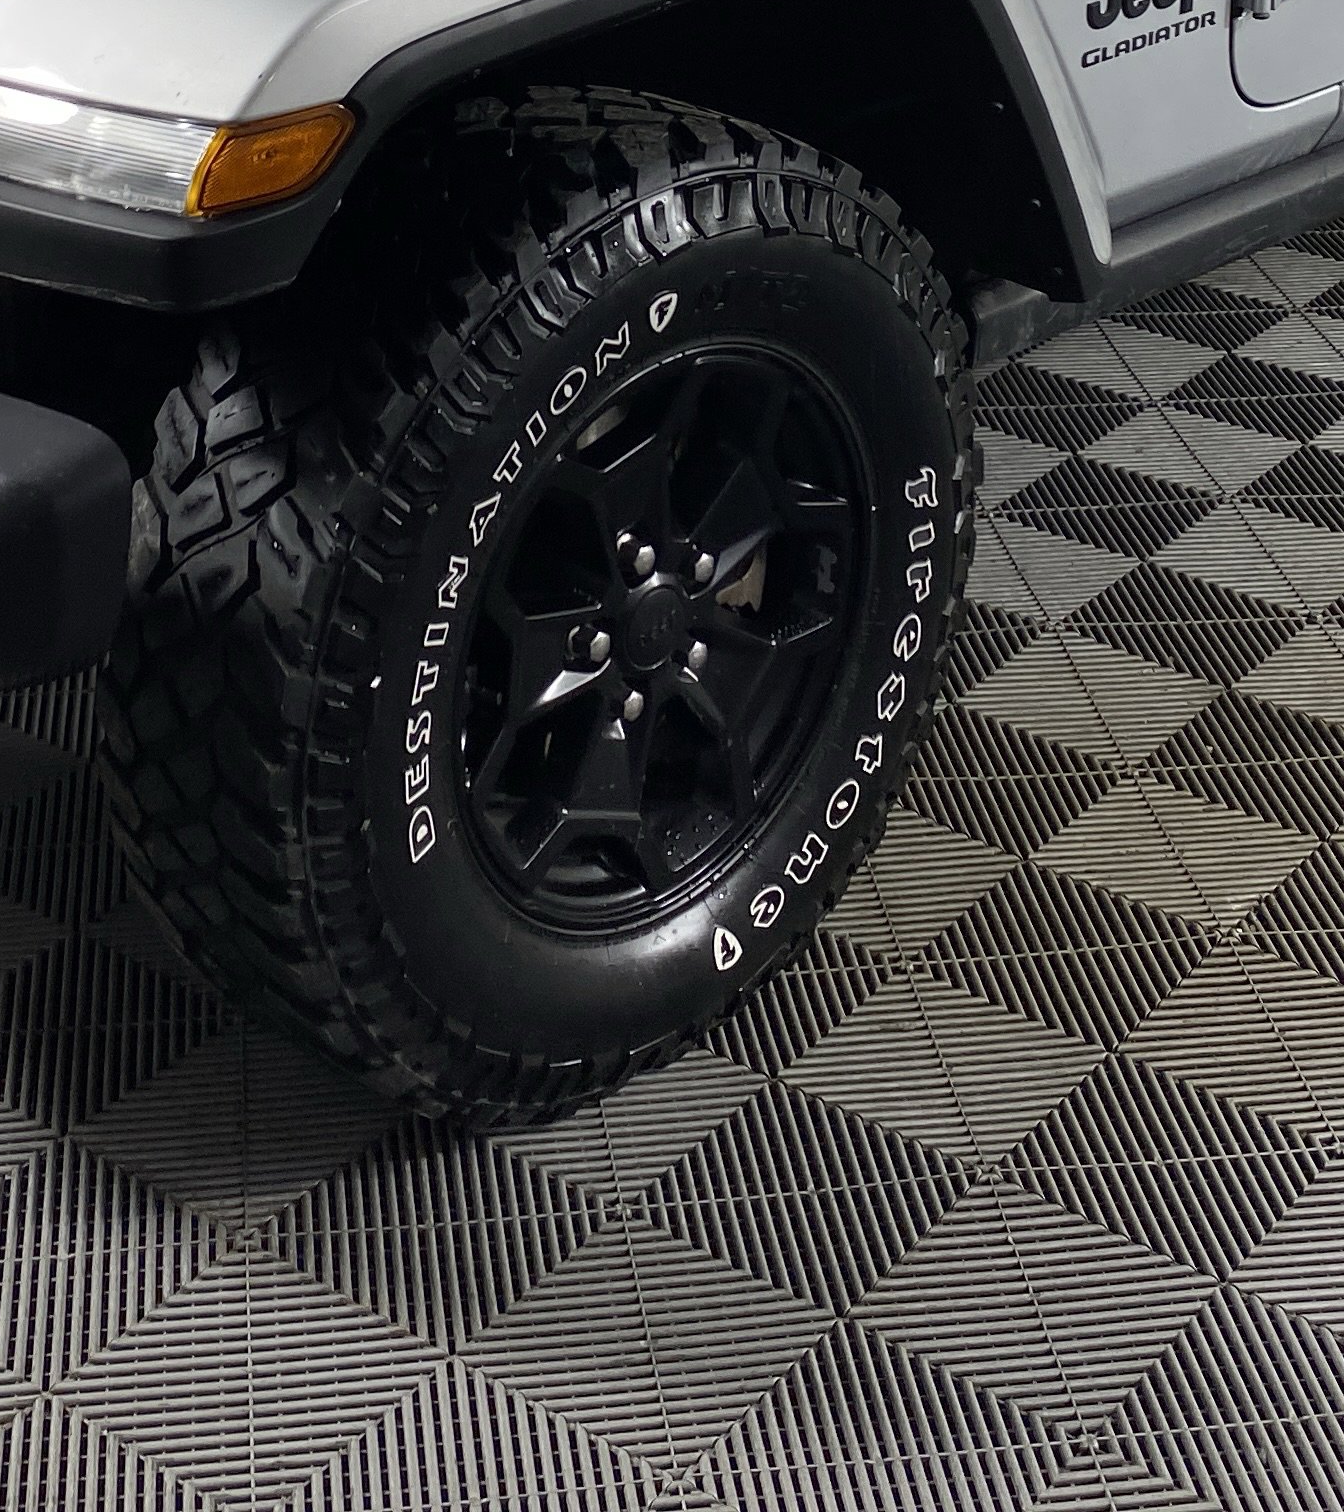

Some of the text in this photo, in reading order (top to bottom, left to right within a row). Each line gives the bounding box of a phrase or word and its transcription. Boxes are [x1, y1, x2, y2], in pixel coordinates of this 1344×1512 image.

[1080, 10, 1217, 69] GLADIATOR
[409, 321, 633, 863] DESTINATION
[751, 466, 938, 929] Firestone
